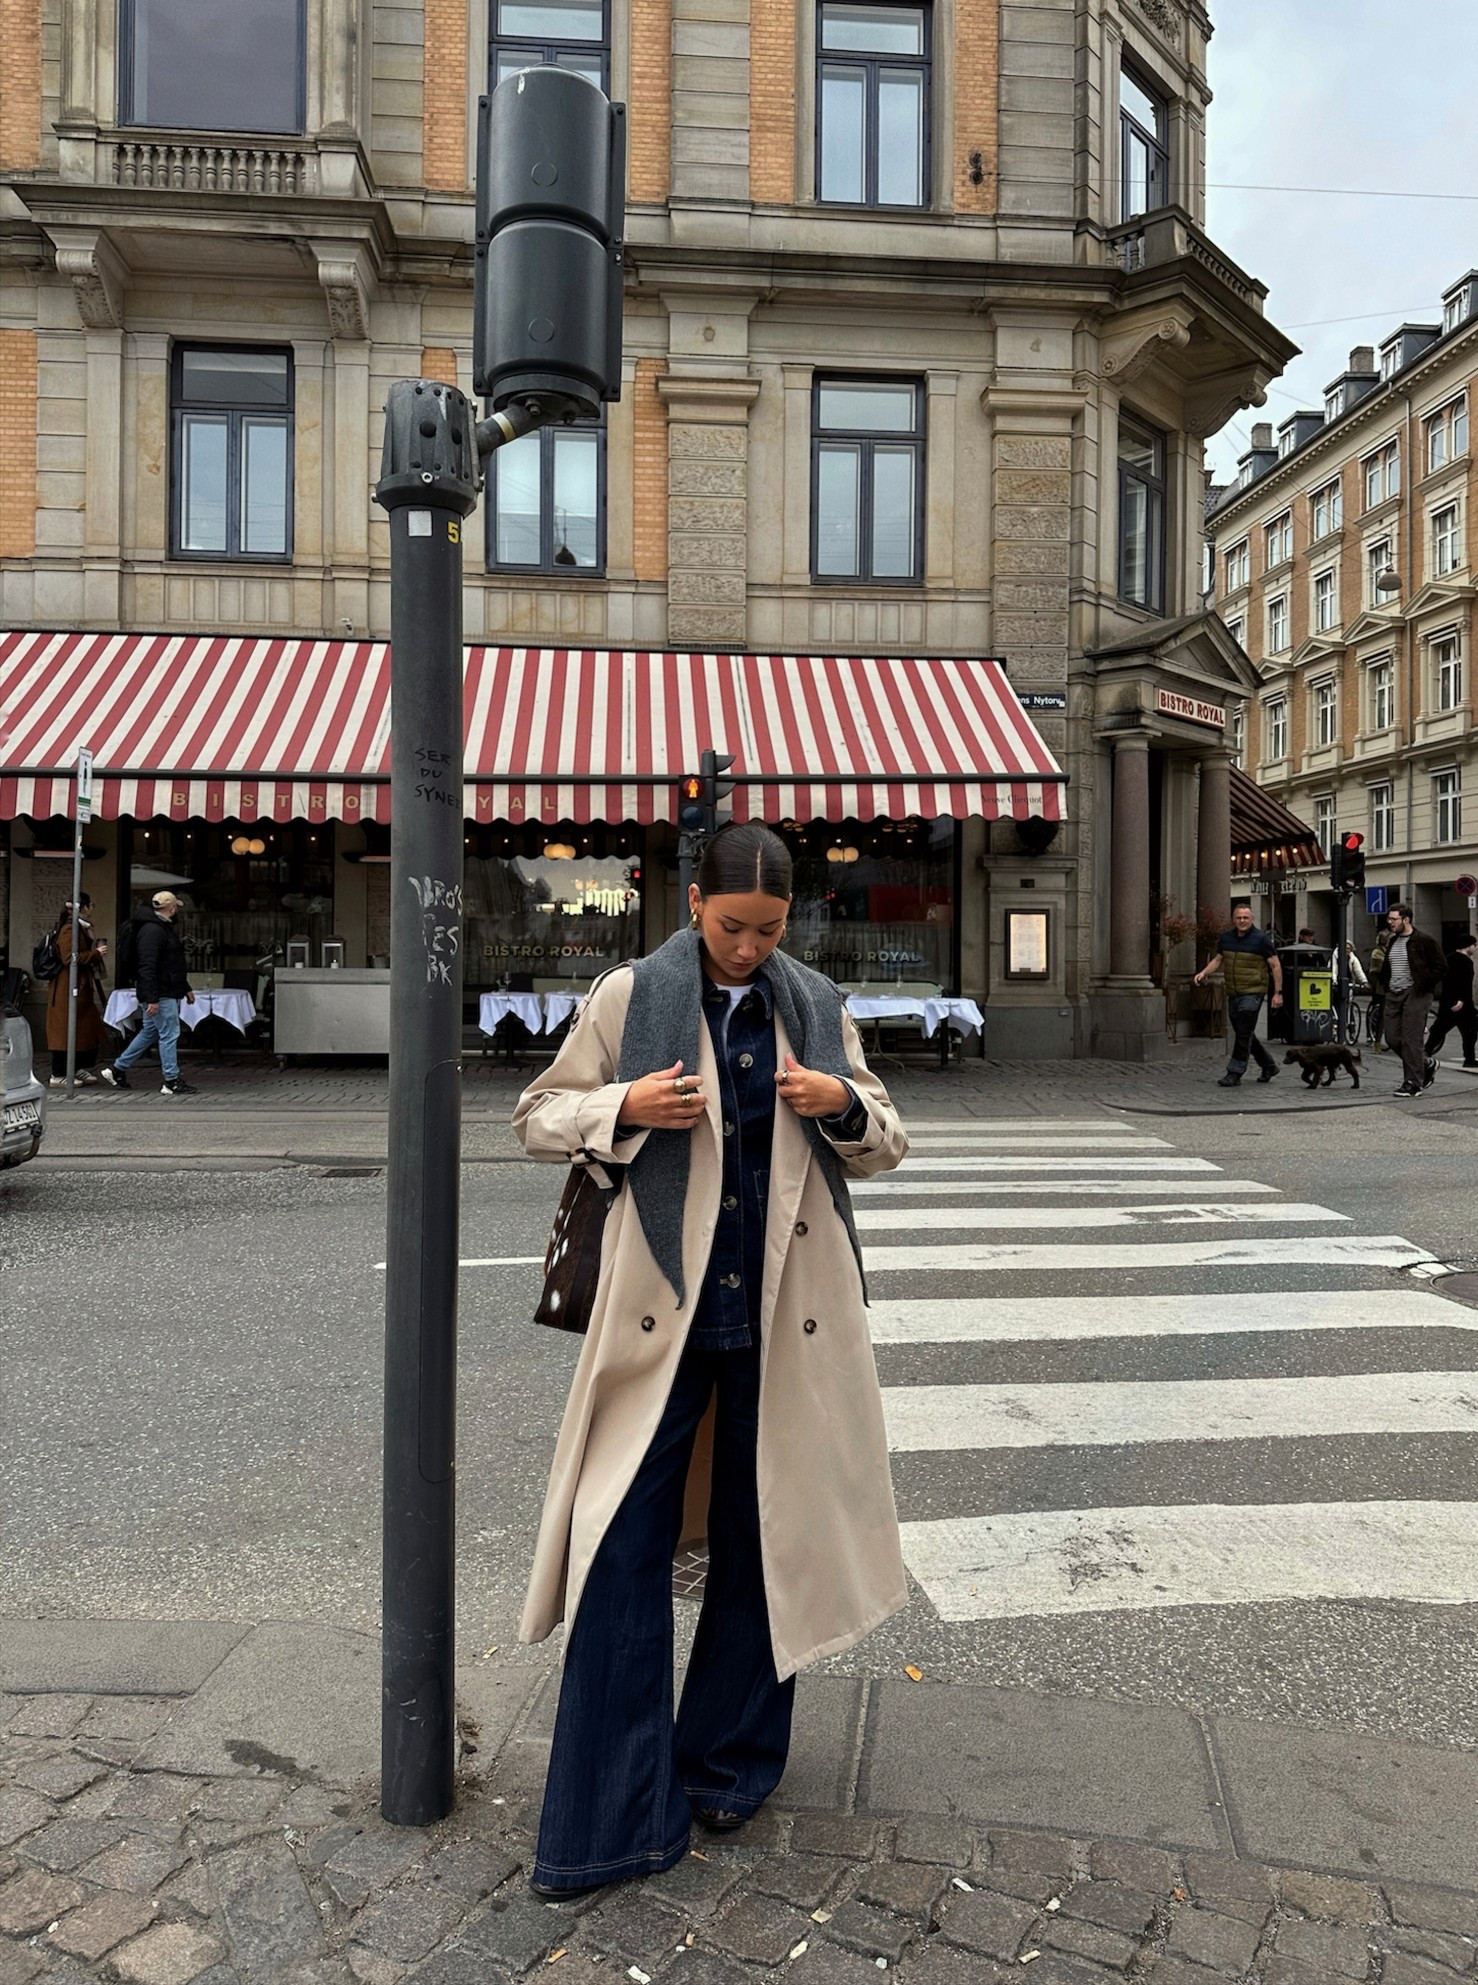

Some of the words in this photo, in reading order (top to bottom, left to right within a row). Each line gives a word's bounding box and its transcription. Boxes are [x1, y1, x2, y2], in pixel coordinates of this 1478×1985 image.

[447, 520, 460, 544] 5
[1033, 695, 1062, 706] Nytorv
[1160, 691, 1195, 716] BISTRO
[1197, 703, 1224, 725] ROYAL
[420, 767, 443, 779] DU
[172, 791, 360, 811] BISTRO
[483, 944, 545, 957] BISTRO
[550, 944, 605, 957] ROYAL
[803, 950, 863, 962] BISTRO
[867, 950, 921, 962] ROYAL
